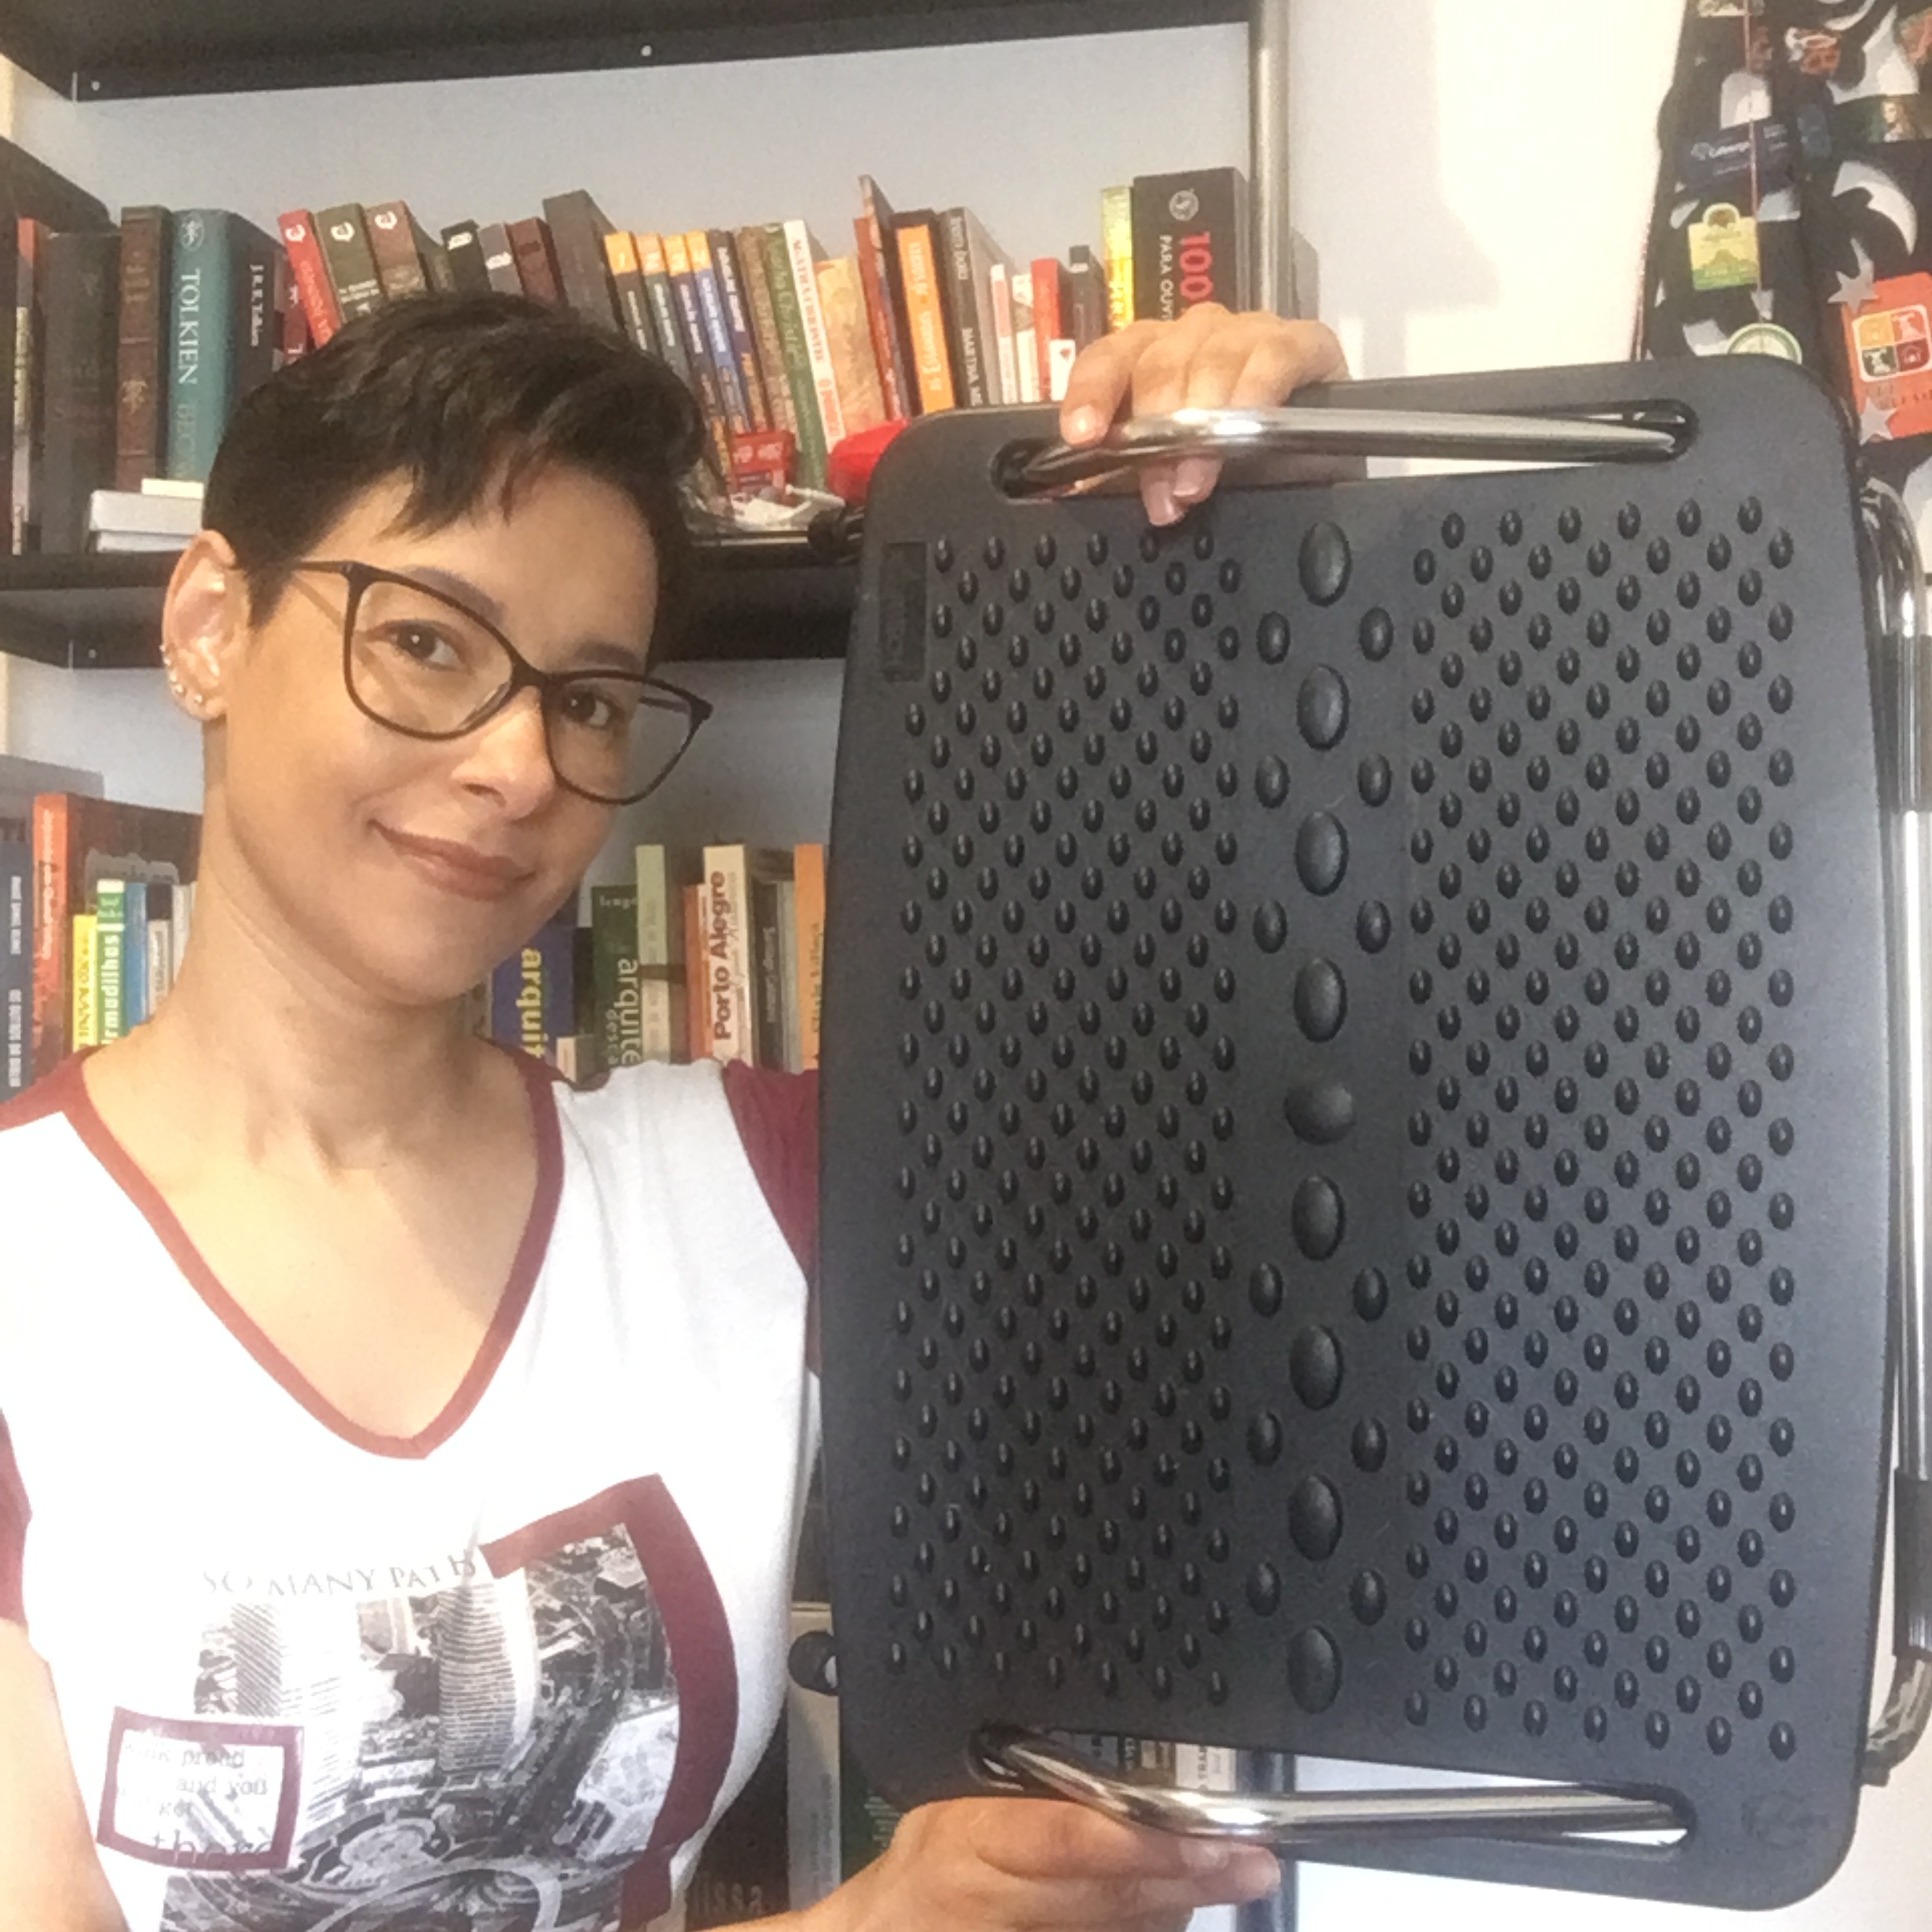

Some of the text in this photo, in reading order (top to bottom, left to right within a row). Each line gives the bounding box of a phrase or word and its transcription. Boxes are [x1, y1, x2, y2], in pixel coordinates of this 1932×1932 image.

[1159, 234, 1173, 274] PARA
[177, 268, 201, 385] TOLKIEN
[707, 870, 732, 1041] Porto Alegre
[268, 1567, 376, 1596] MANY
